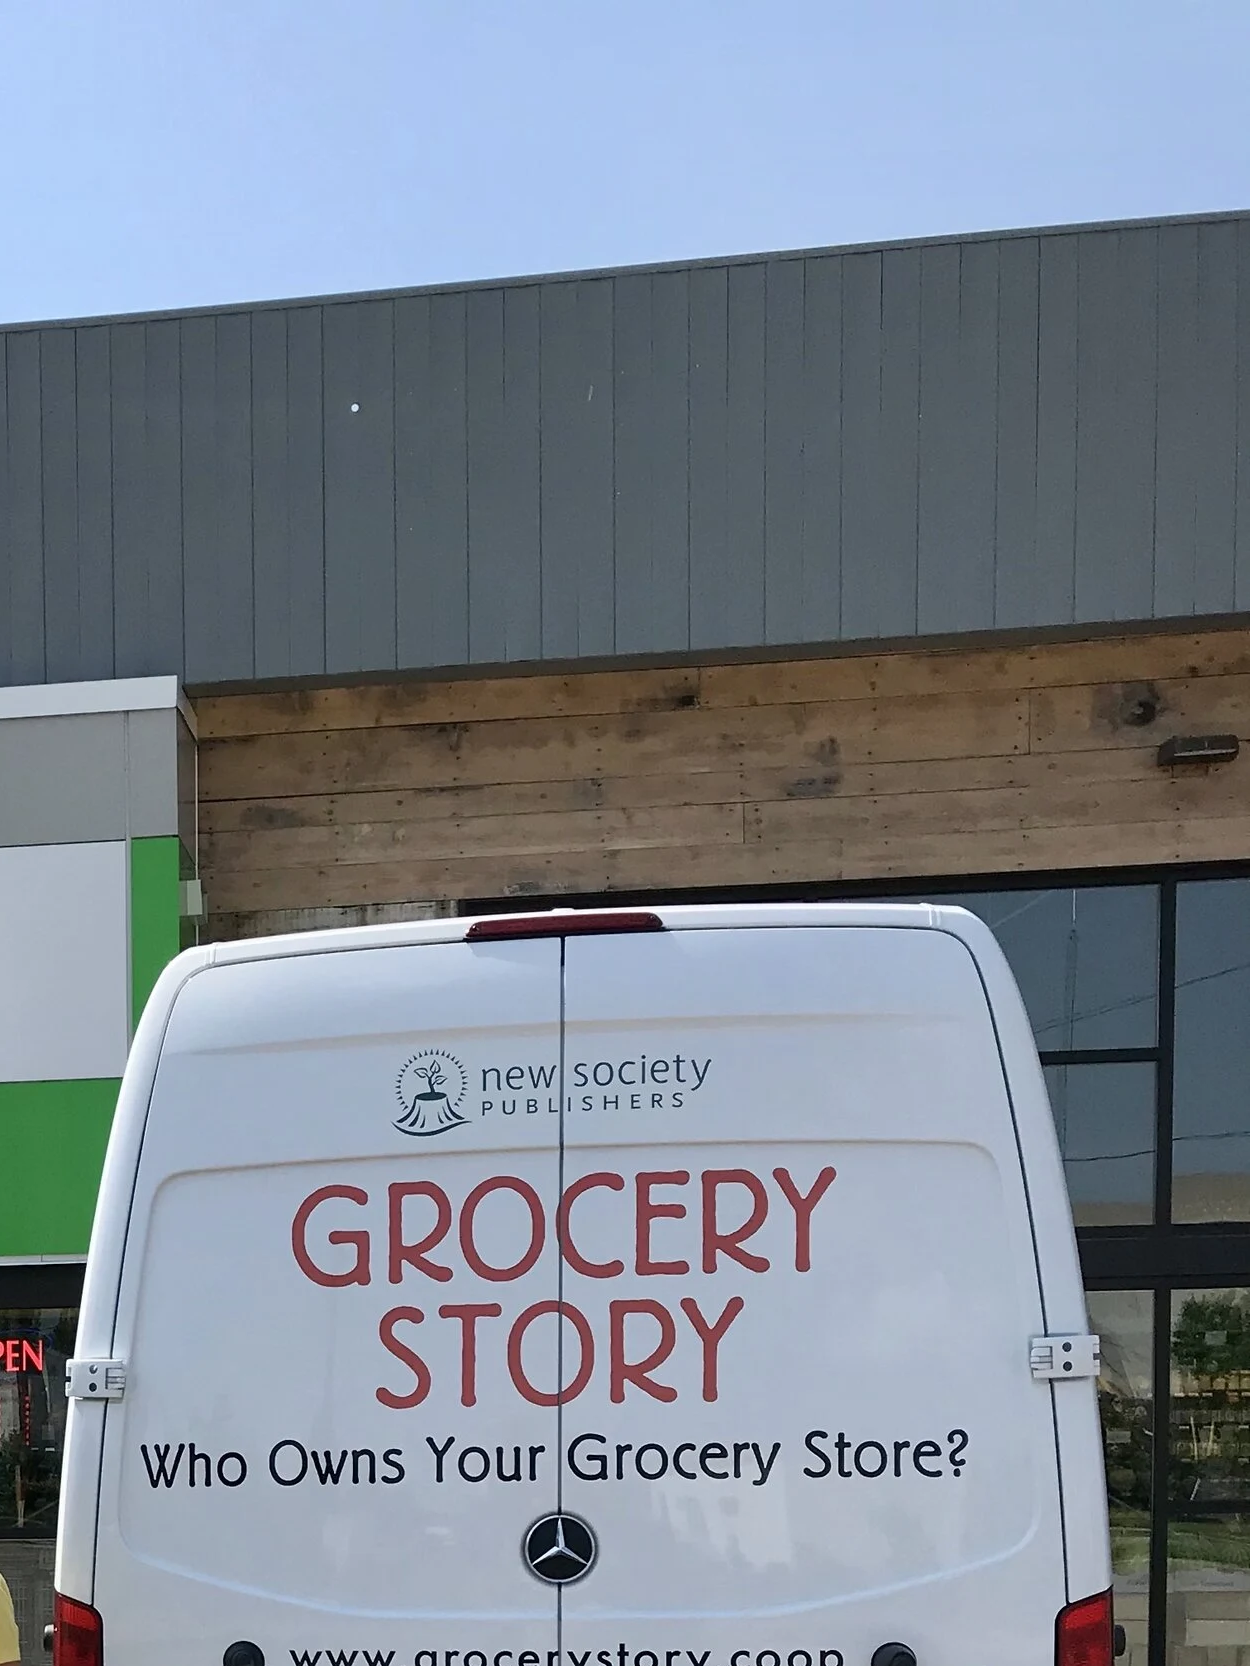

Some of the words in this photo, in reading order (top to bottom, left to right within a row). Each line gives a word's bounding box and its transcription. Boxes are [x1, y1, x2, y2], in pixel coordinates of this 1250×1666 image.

[482, 1063, 556, 1092] new
[574, 1052, 711, 1091] society
[481, 1092, 685, 1116] PUBLISHERS
[291, 1166, 837, 1287] GROCERY
[375, 1296, 744, 1409] STORY
[140, 1442, 248, 1488] Who
[268, 1439, 406, 1486] Owns
[426, 1436, 546, 1483] Your
[567, 1432, 781, 1486] Grocery
[803, 1429, 969, 1478] Store?
